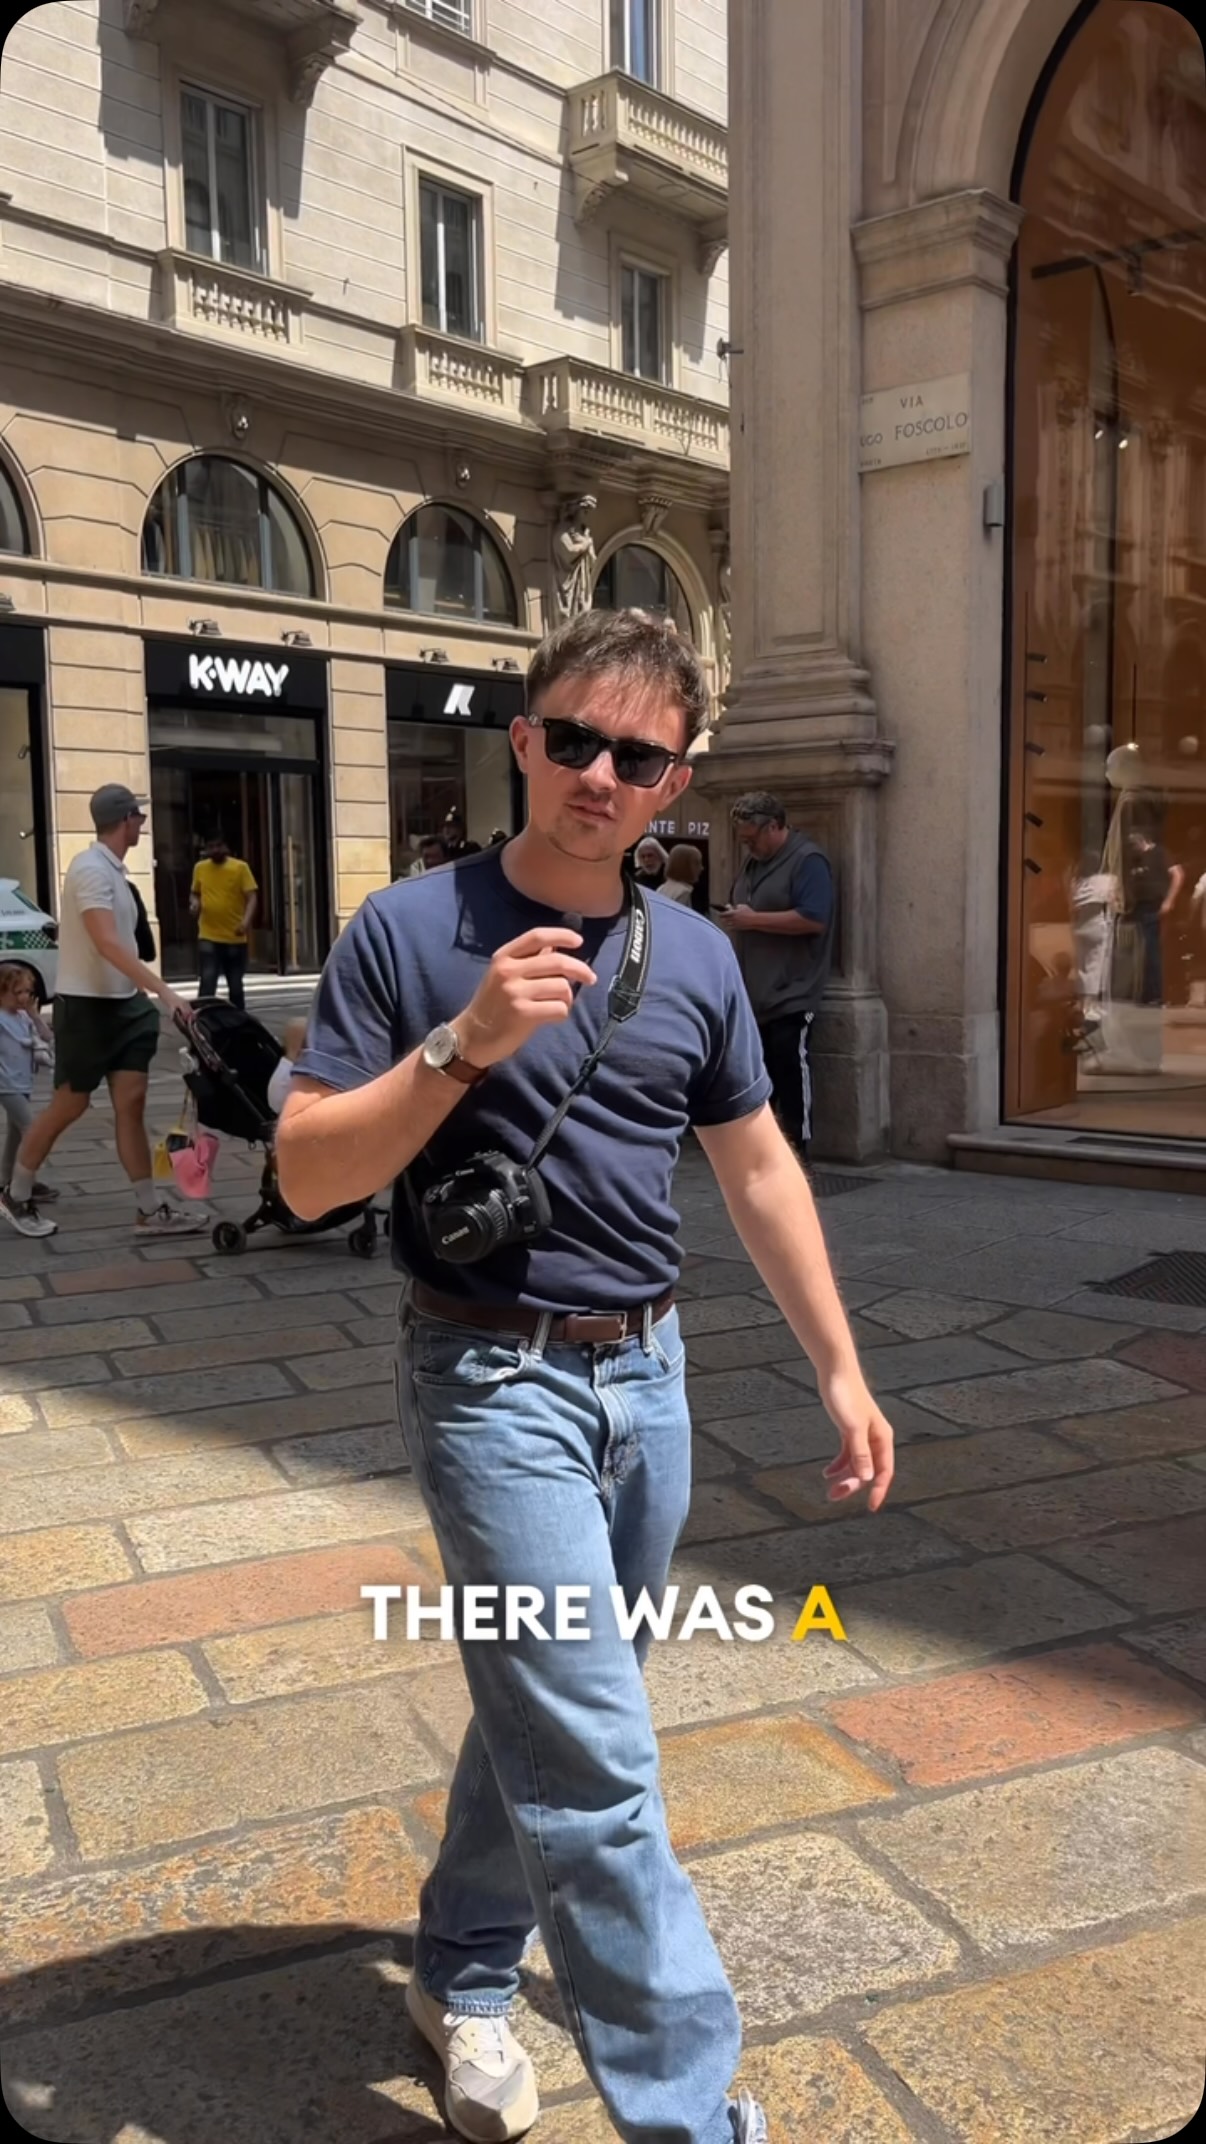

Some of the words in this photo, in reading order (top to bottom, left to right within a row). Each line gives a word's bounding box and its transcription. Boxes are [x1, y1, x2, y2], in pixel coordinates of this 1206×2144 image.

[900, 395, 923, 409] VIA
[895, 412, 968, 441] FOSCOLO
[644, 820, 675, 835] NTE
[631, 908, 645, 964] Canon
